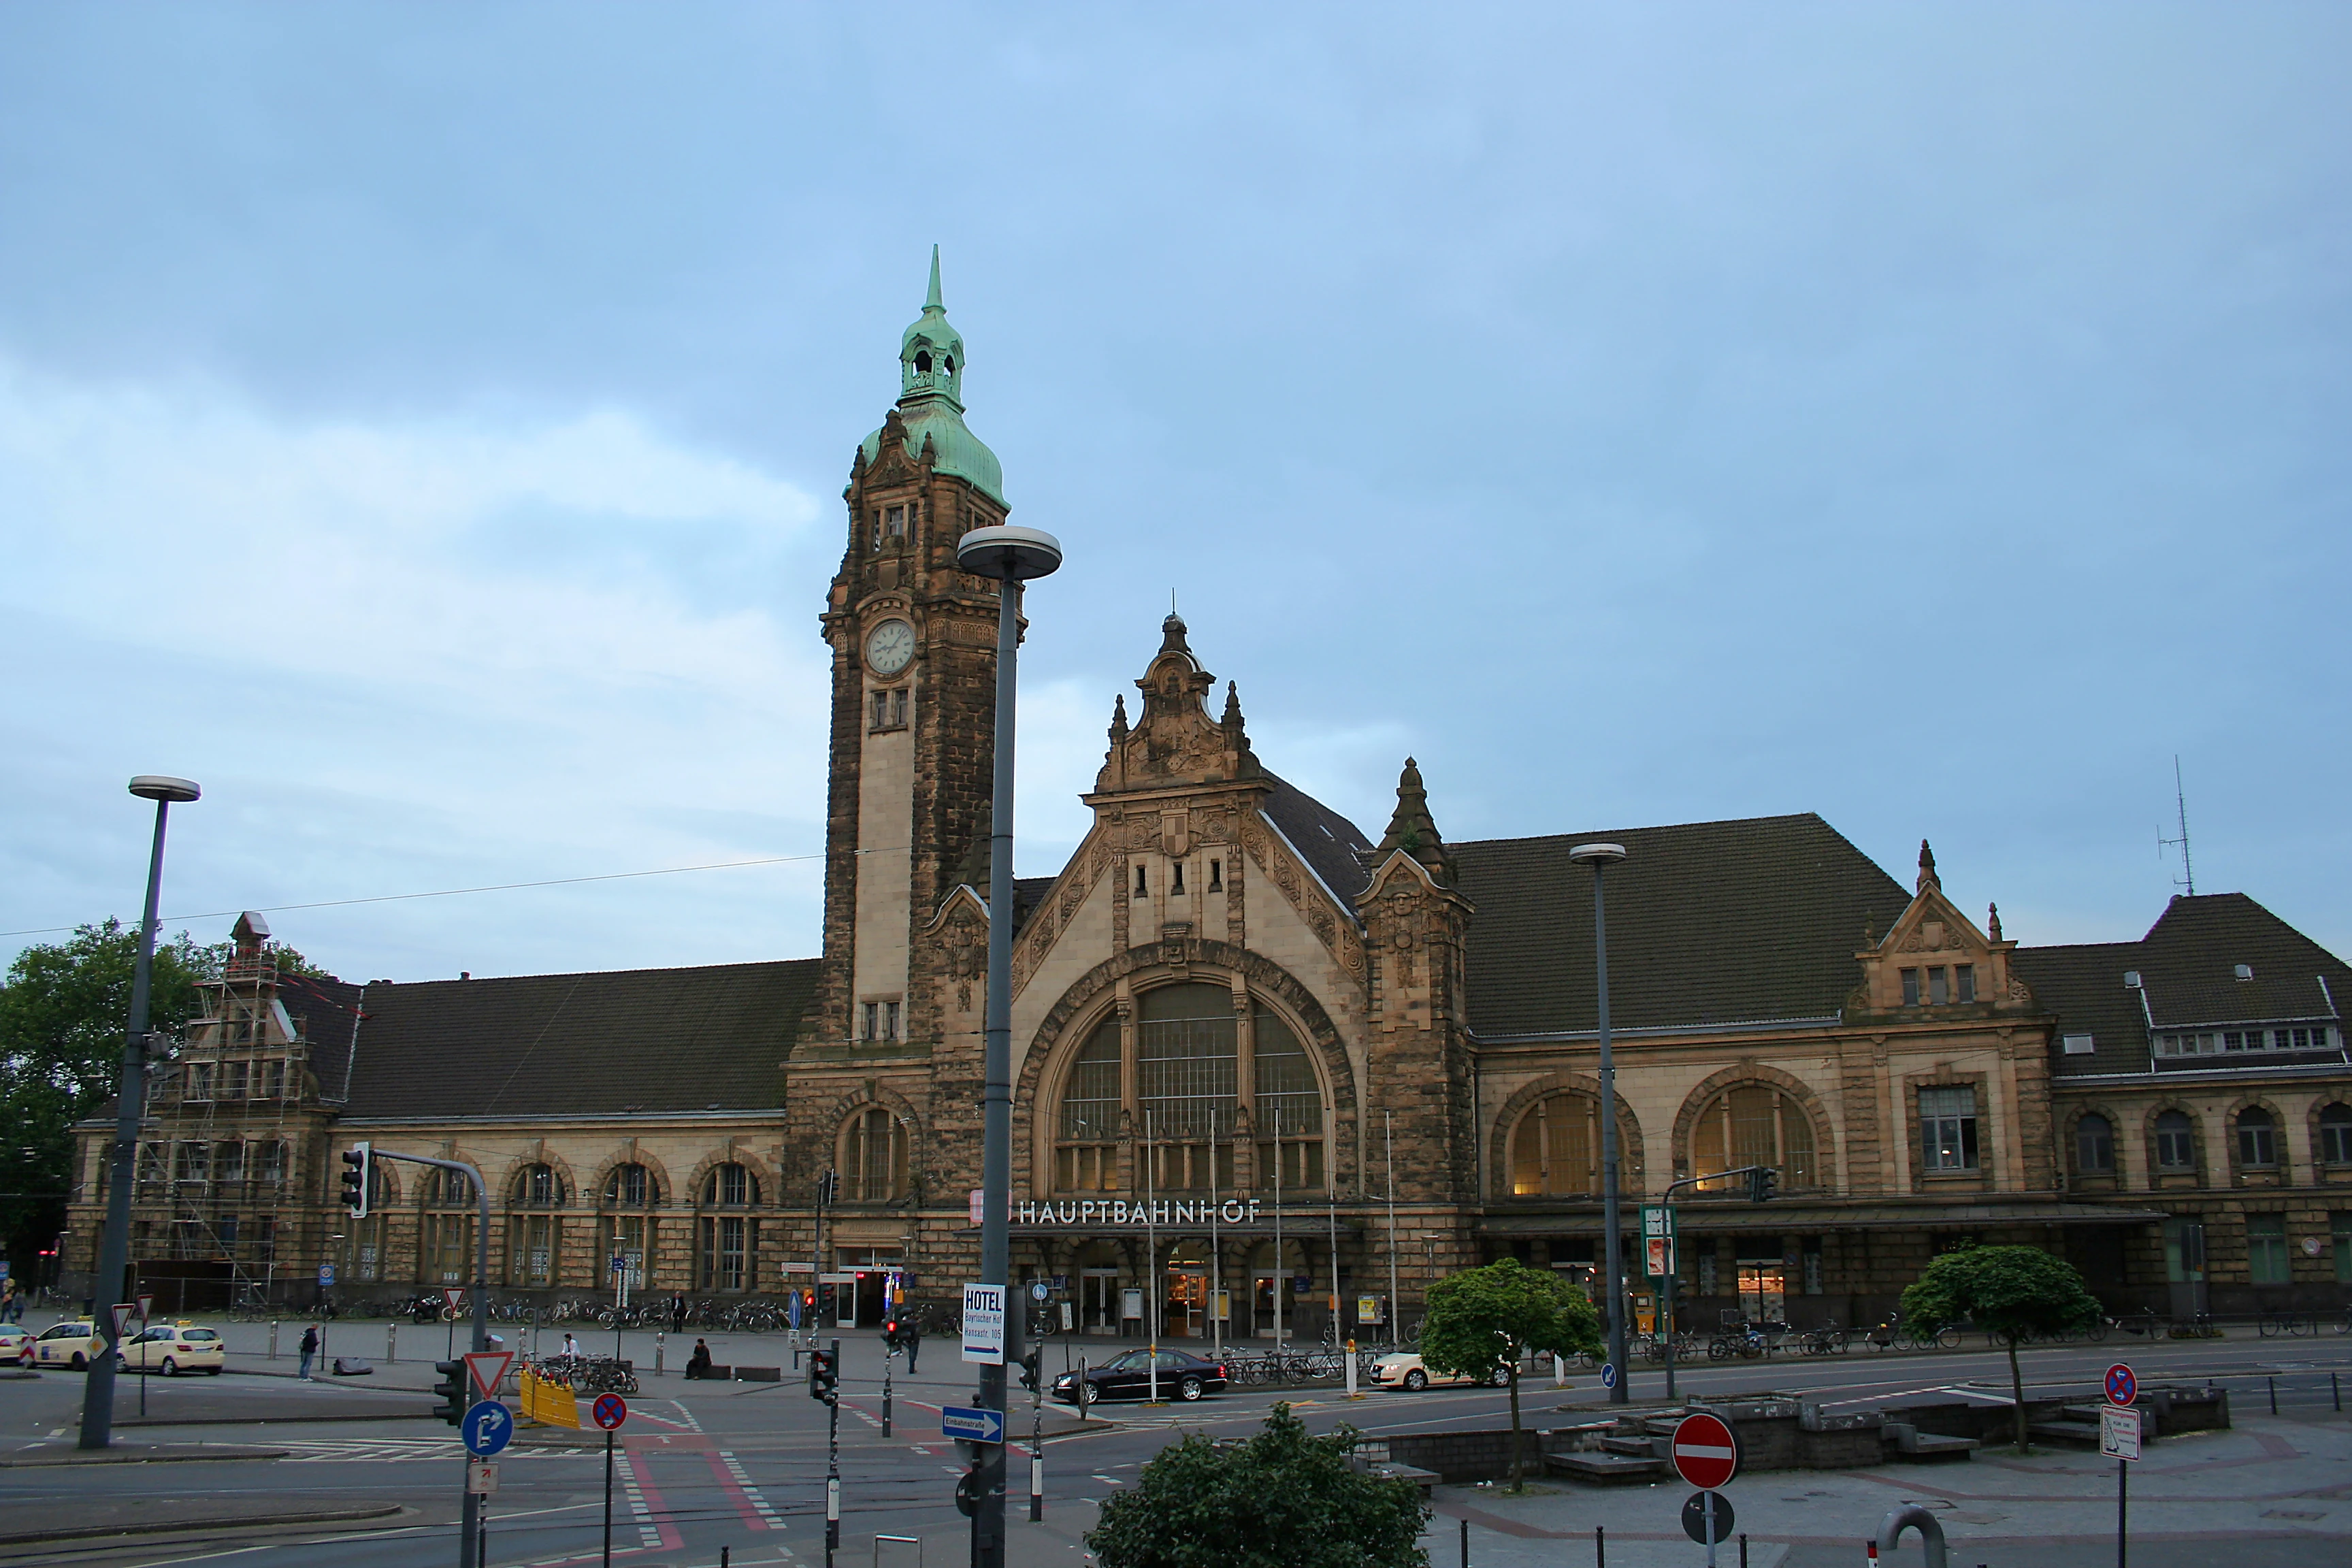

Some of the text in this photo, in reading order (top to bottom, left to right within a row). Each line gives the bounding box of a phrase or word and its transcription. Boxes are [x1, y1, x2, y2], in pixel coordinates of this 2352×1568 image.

[1019, 1199, 1260, 1224] HAUPTBAHNHOF
[966, 1290, 1002, 1312] HOTEL
[965, 1311, 1002, 1324] Bayrischer Hof
[964, 1326, 1002, 1339] Hansastr. 105
[946, 1416, 985, 1429] Einbahnstraße
